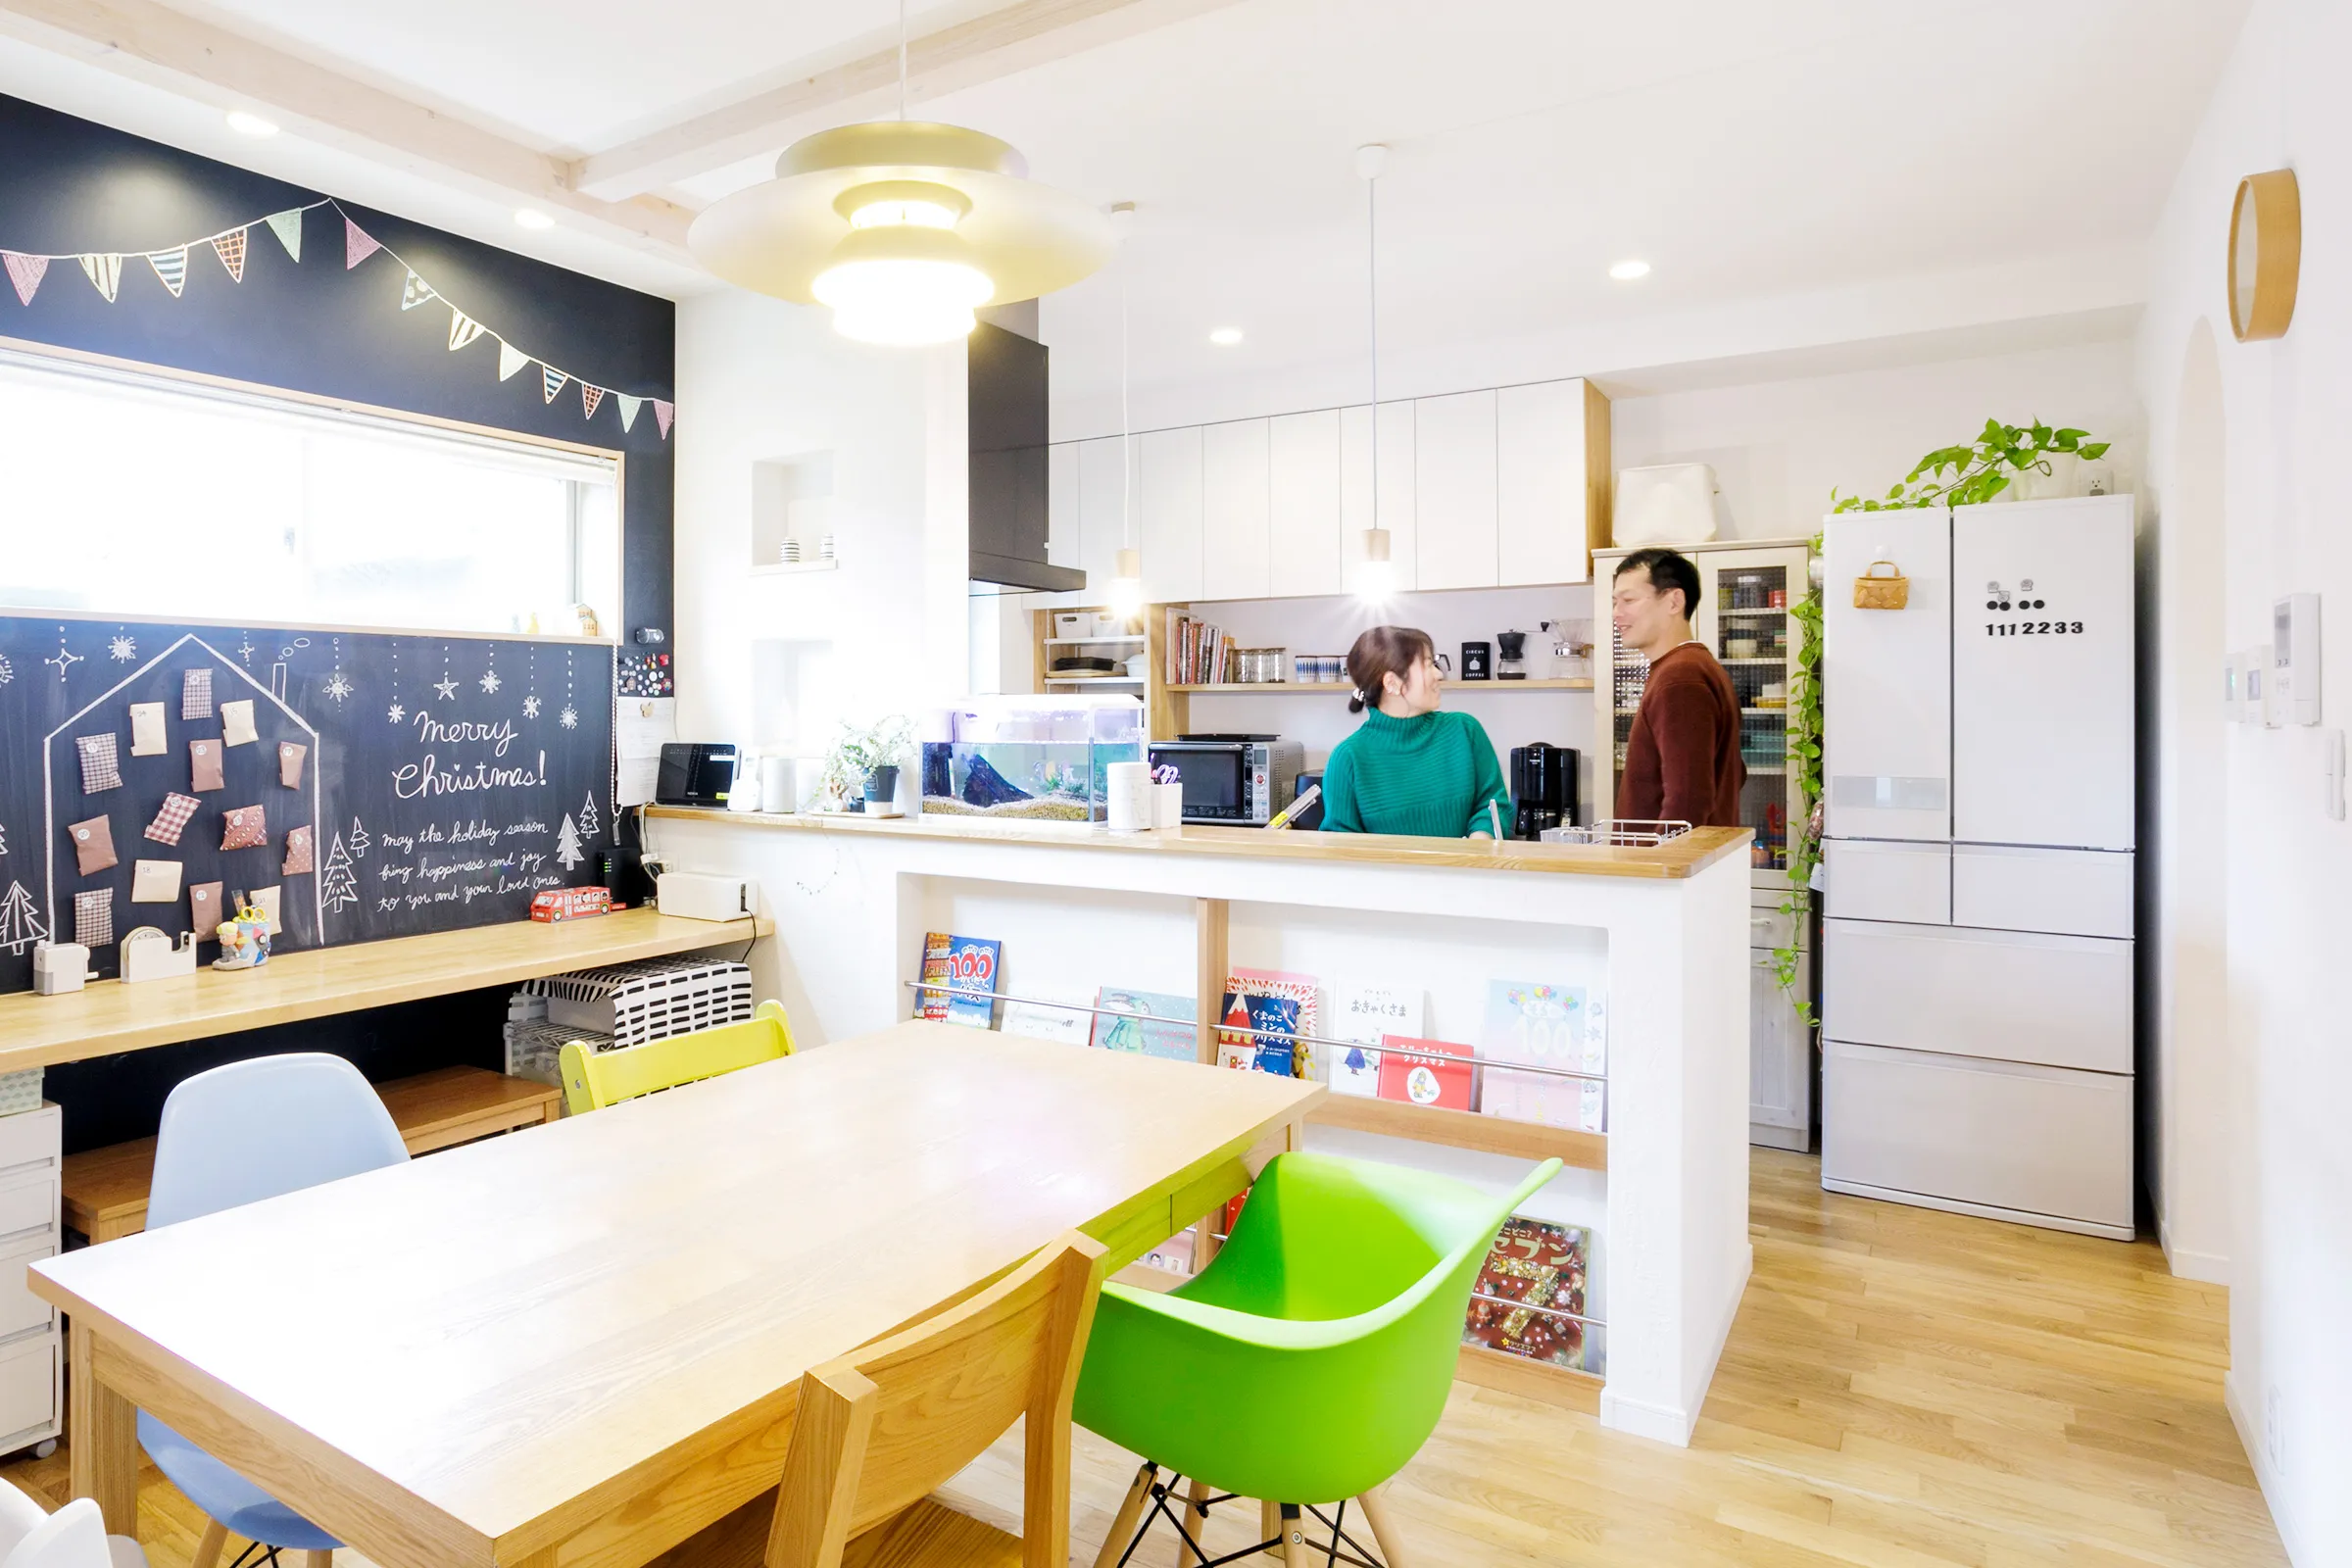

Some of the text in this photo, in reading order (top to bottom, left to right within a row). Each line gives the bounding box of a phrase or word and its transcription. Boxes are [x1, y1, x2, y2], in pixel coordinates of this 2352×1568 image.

[1985, 621, 2083, 636] 1112233
[413, 710, 518, 757] Merry
[392, 750, 547, 799] Christmas!
[418, 823, 445, 844] the
[448, 819, 501, 846] holiday
[504, 821, 548, 835] season
[378, 848, 547, 884] bring happiness and joy
[376, 897, 400, 912] to
[406, 893, 431, 910] you
[434, 886, 459, 904] and
[463, 883, 492, 904] your
[498, 875, 530, 896] loved
[950, 952, 993, 979] 100
[1252, 1009, 1283, 1022] くまのこ
[1350, 999, 1406, 1017] おきゃくさま
[1261, 1021, 1285, 1033] ミンの
[1403, 1054, 1446, 1067] クリスマス
[1499, 1227, 1533, 1238] こどこ?
[1491, 1236, 1574, 1265] セブン
